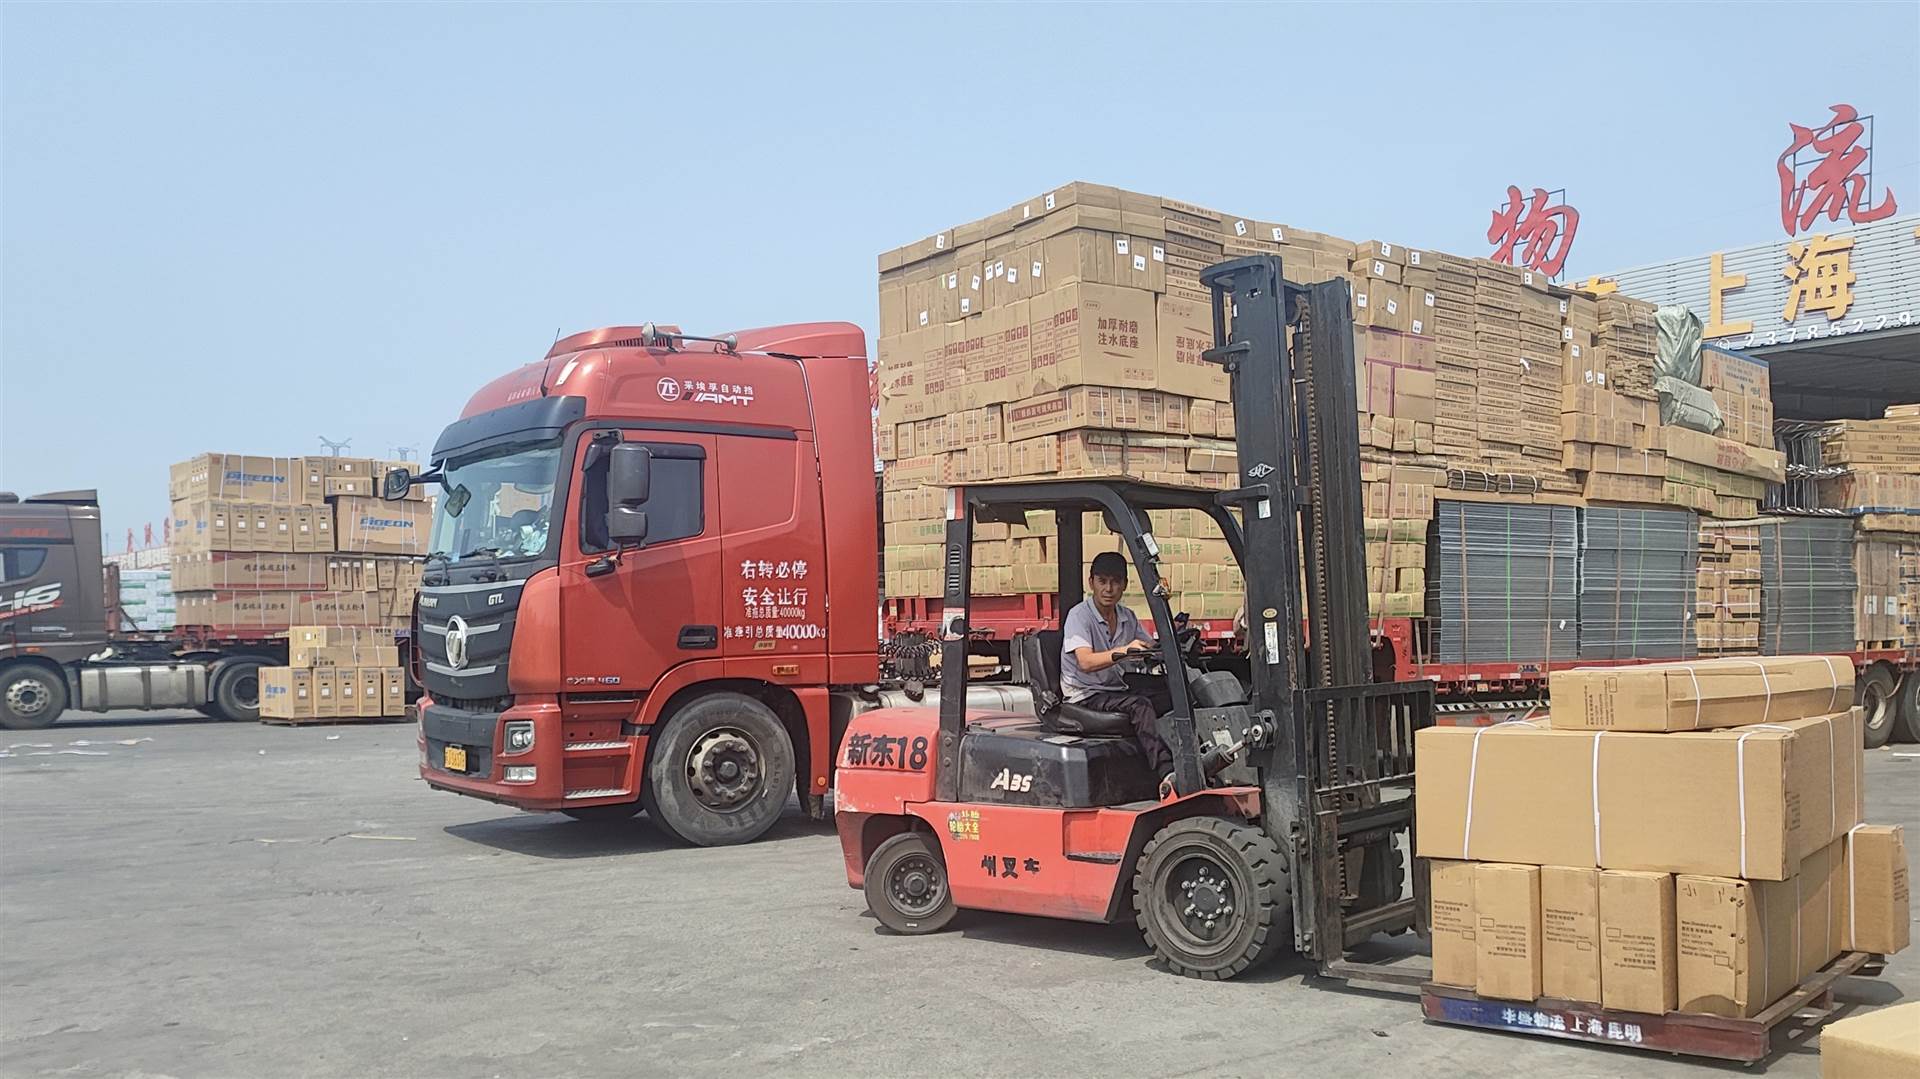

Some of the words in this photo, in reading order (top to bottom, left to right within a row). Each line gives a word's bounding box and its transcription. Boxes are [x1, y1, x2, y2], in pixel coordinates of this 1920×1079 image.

[1703, 234, 1856, 338] 上海
[1098, 317, 1138, 334] 加厚耐磨
[1098, 332, 1139, 349] 注水底座
[741, 560, 808, 579] 右转必停
[488, 593, 504, 606] GTL
[742, 587, 808, 606] 安全让行
[848, 733, 928, 770] 新东18
[1570, 1016, 1604, 1037] 上海
[1607, 1022, 1643, 1043] 昆明
